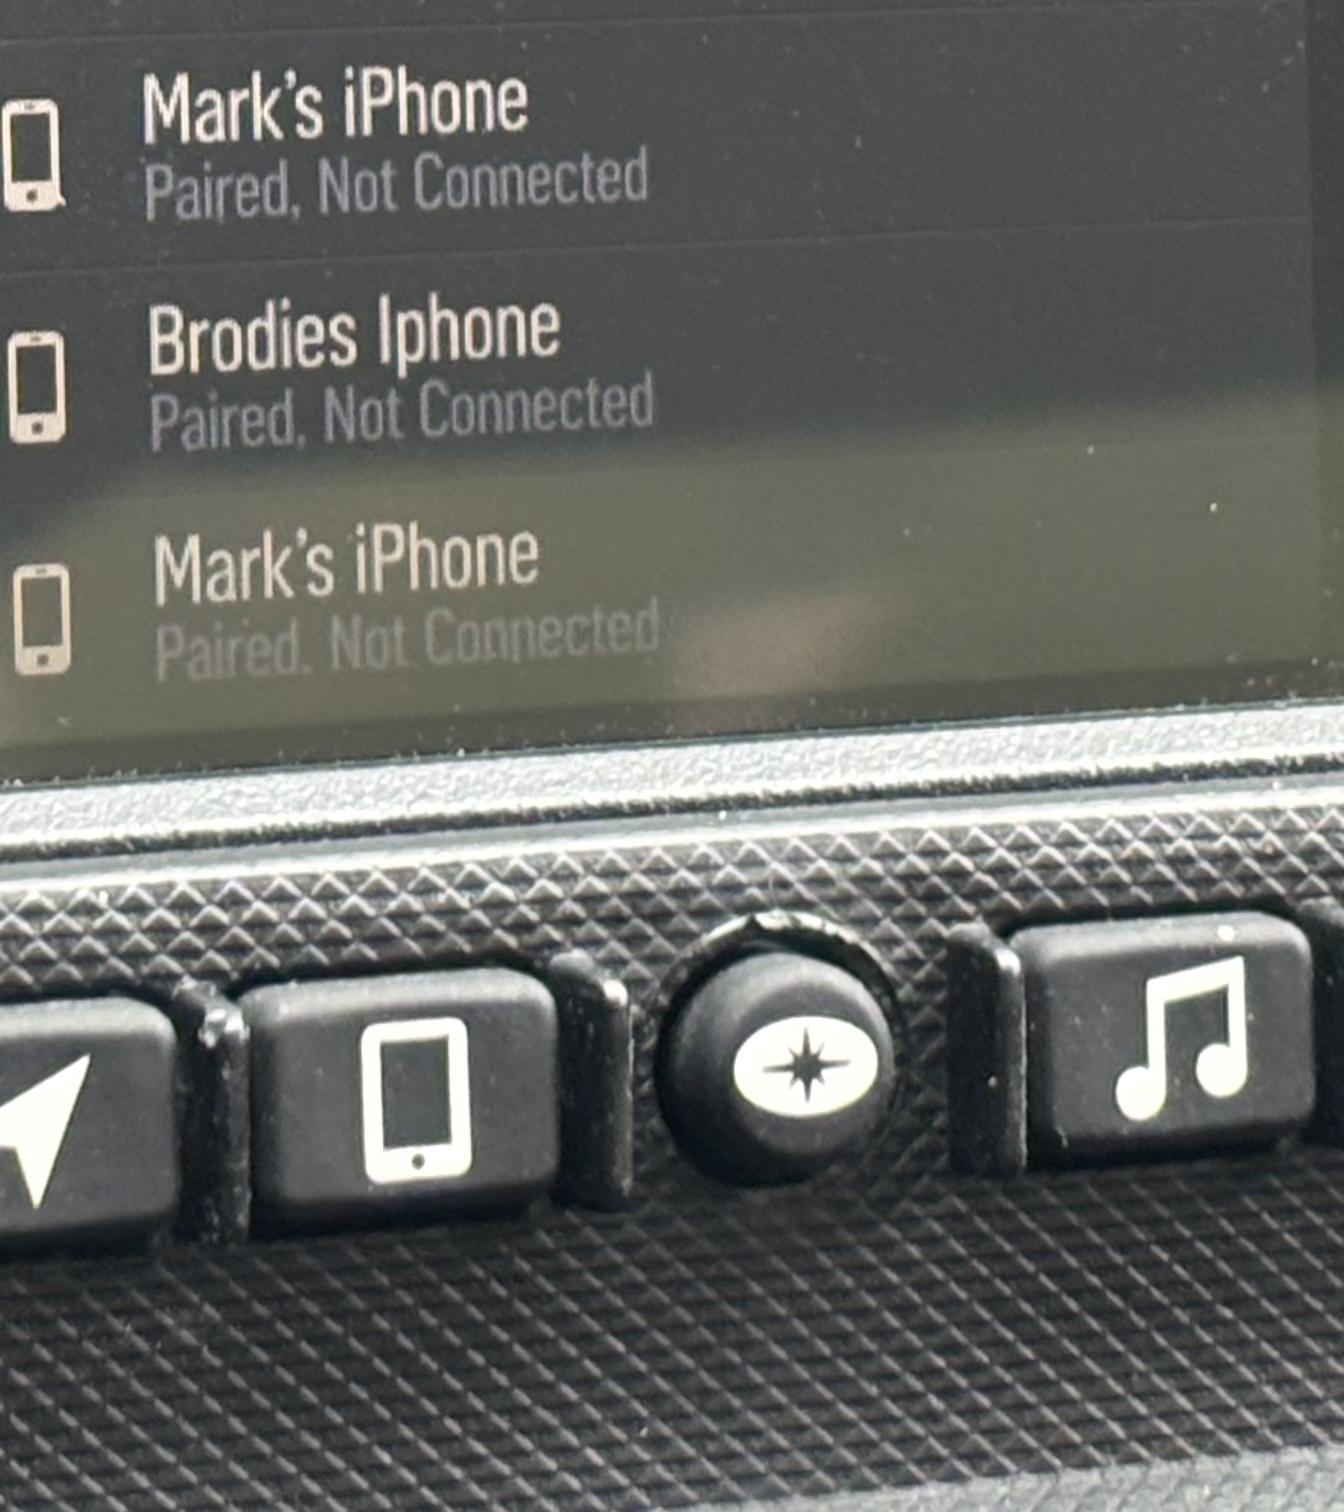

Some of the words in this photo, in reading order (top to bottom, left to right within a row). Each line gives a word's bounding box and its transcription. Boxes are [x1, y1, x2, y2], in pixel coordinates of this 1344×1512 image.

[142, 68, 324, 145] Mark's
[344, 65, 529, 136] iPhone
[318, 155, 397, 213] Not
[413, 145, 649, 209] Connected
[149, 298, 358, 376] Brodies
[378, 292, 561, 379] Iphone
[323, 385, 403, 444] Not
[419, 369, 654, 439] Connected
[155, 528, 336, 606] Mark's
[355, 521, 540, 593] iPhone
[328, 612, 408, 672] Not
[424, 595, 659, 666] Connected
